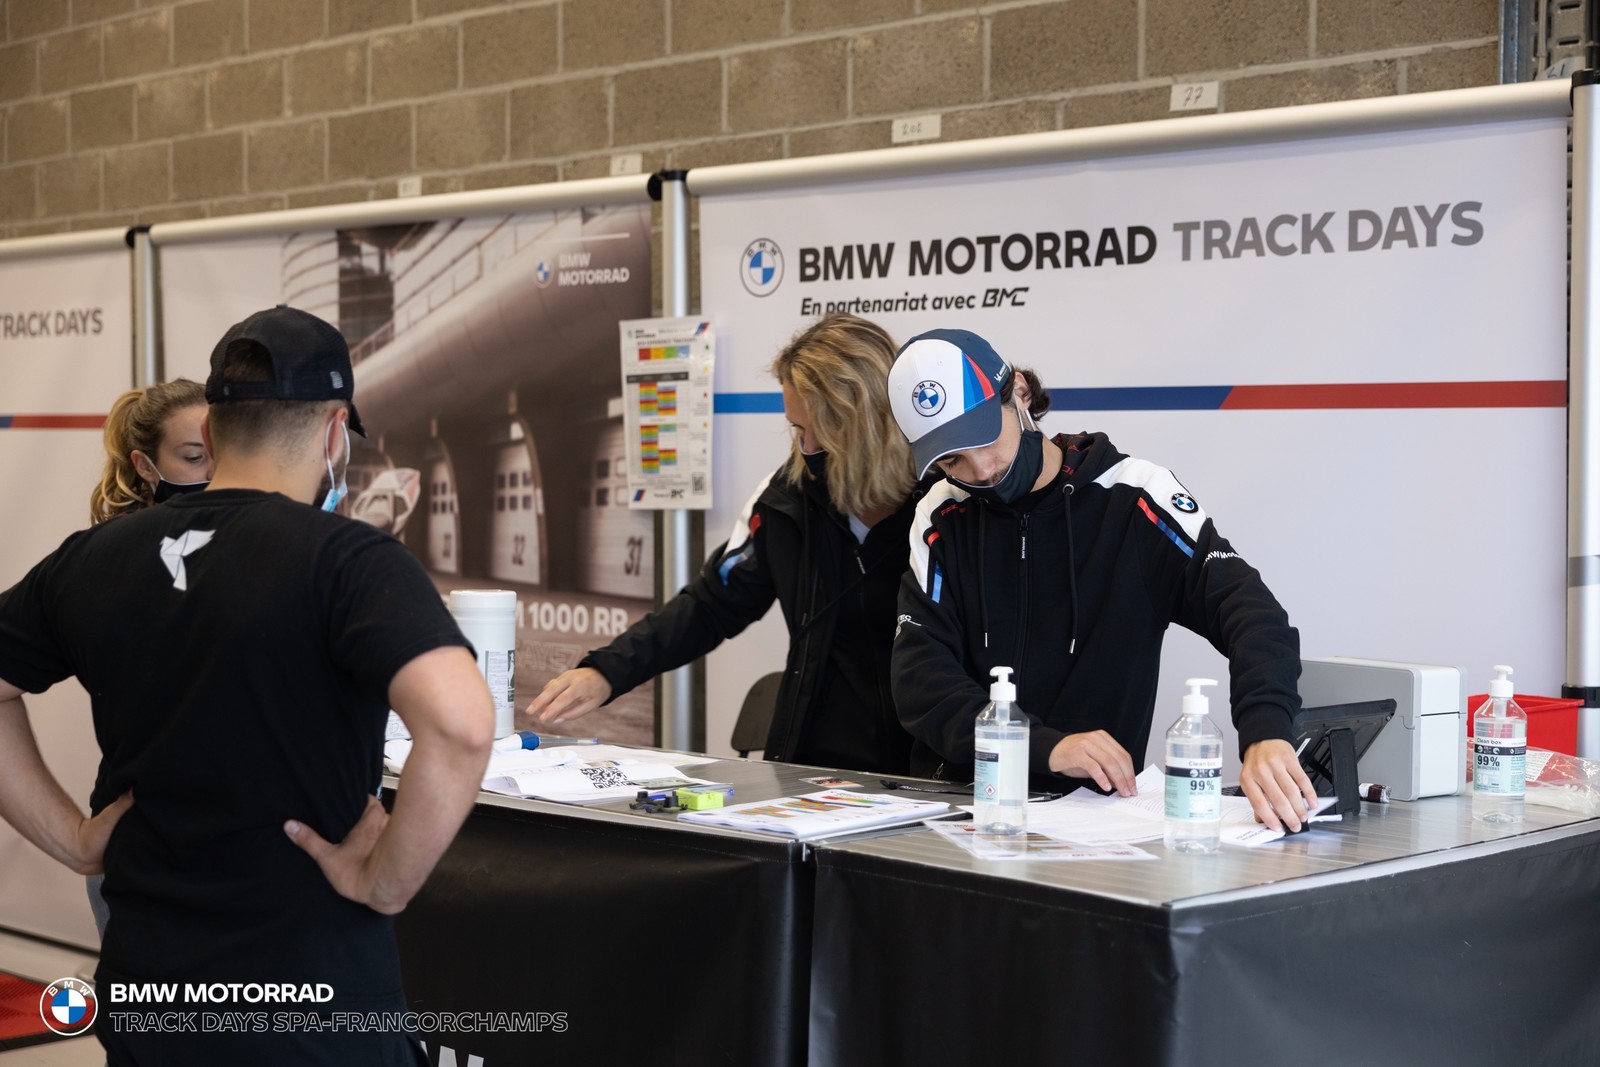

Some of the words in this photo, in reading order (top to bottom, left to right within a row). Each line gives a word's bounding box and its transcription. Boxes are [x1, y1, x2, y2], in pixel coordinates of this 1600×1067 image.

[798, 241, 895, 283] BMW
[908, 225, 1158, 277] MOTORRAD
[1172, 211, 1336, 262] TRACK
[1348, 201, 1485, 252] DAYS
[559, 252, 592, 269] BMW
[558, 267, 630, 286] MOTORRAD
[801, 298, 822, 316] En
[826, 292, 927, 315] partenariat
[936, 293, 976, 310] avec
[981, 287, 1030, 308] BMC
[55, 307, 104, 336] DAYS
[624, 535, 643, 577] 31
[528, 601, 589, 634] 1000
[593, 607, 629, 635] RR
[1477, 755, 1500, 767] 99%
[1190, 780, 1215, 791] 99%
